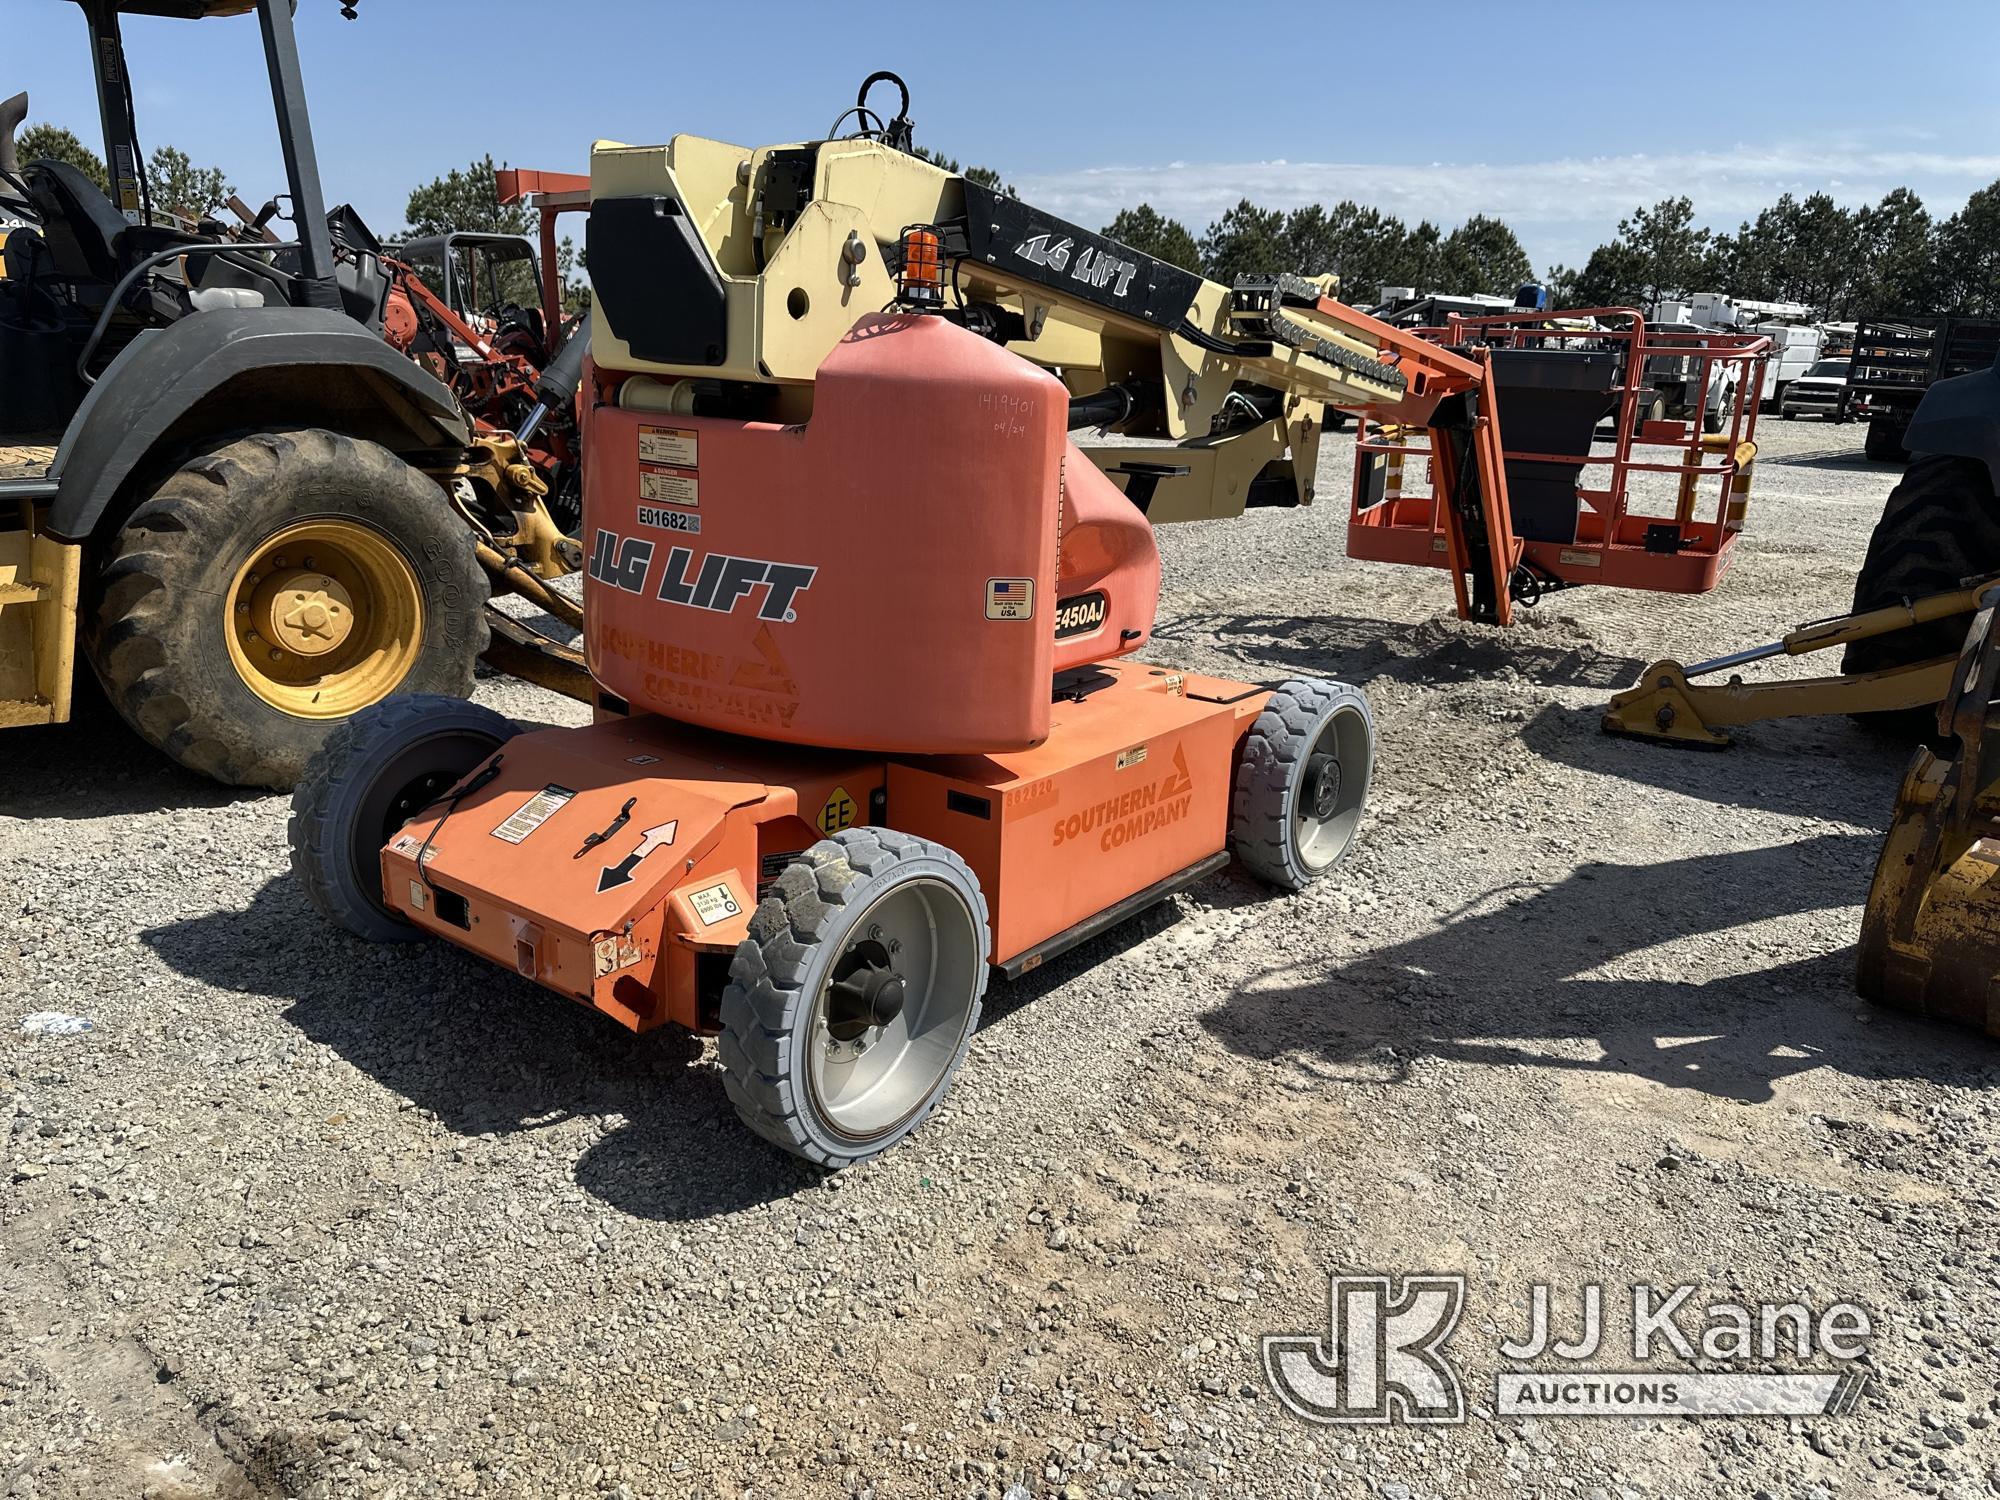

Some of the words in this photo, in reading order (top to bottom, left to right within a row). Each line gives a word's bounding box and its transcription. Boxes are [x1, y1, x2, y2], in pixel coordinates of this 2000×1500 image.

[1071, 247, 1137, 297] LIFT
[978, 393, 1034, 417] 1419401
[994, 417, 1025, 439] 04/24
[639, 507, 688, 530] E01682
[589, 528, 656, 595] JLG
[825, 799, 850, 833] EE
[1053, 783, 1157, 847] SOUTHERN
[1100, 795, 1192, 852] COMPANY
